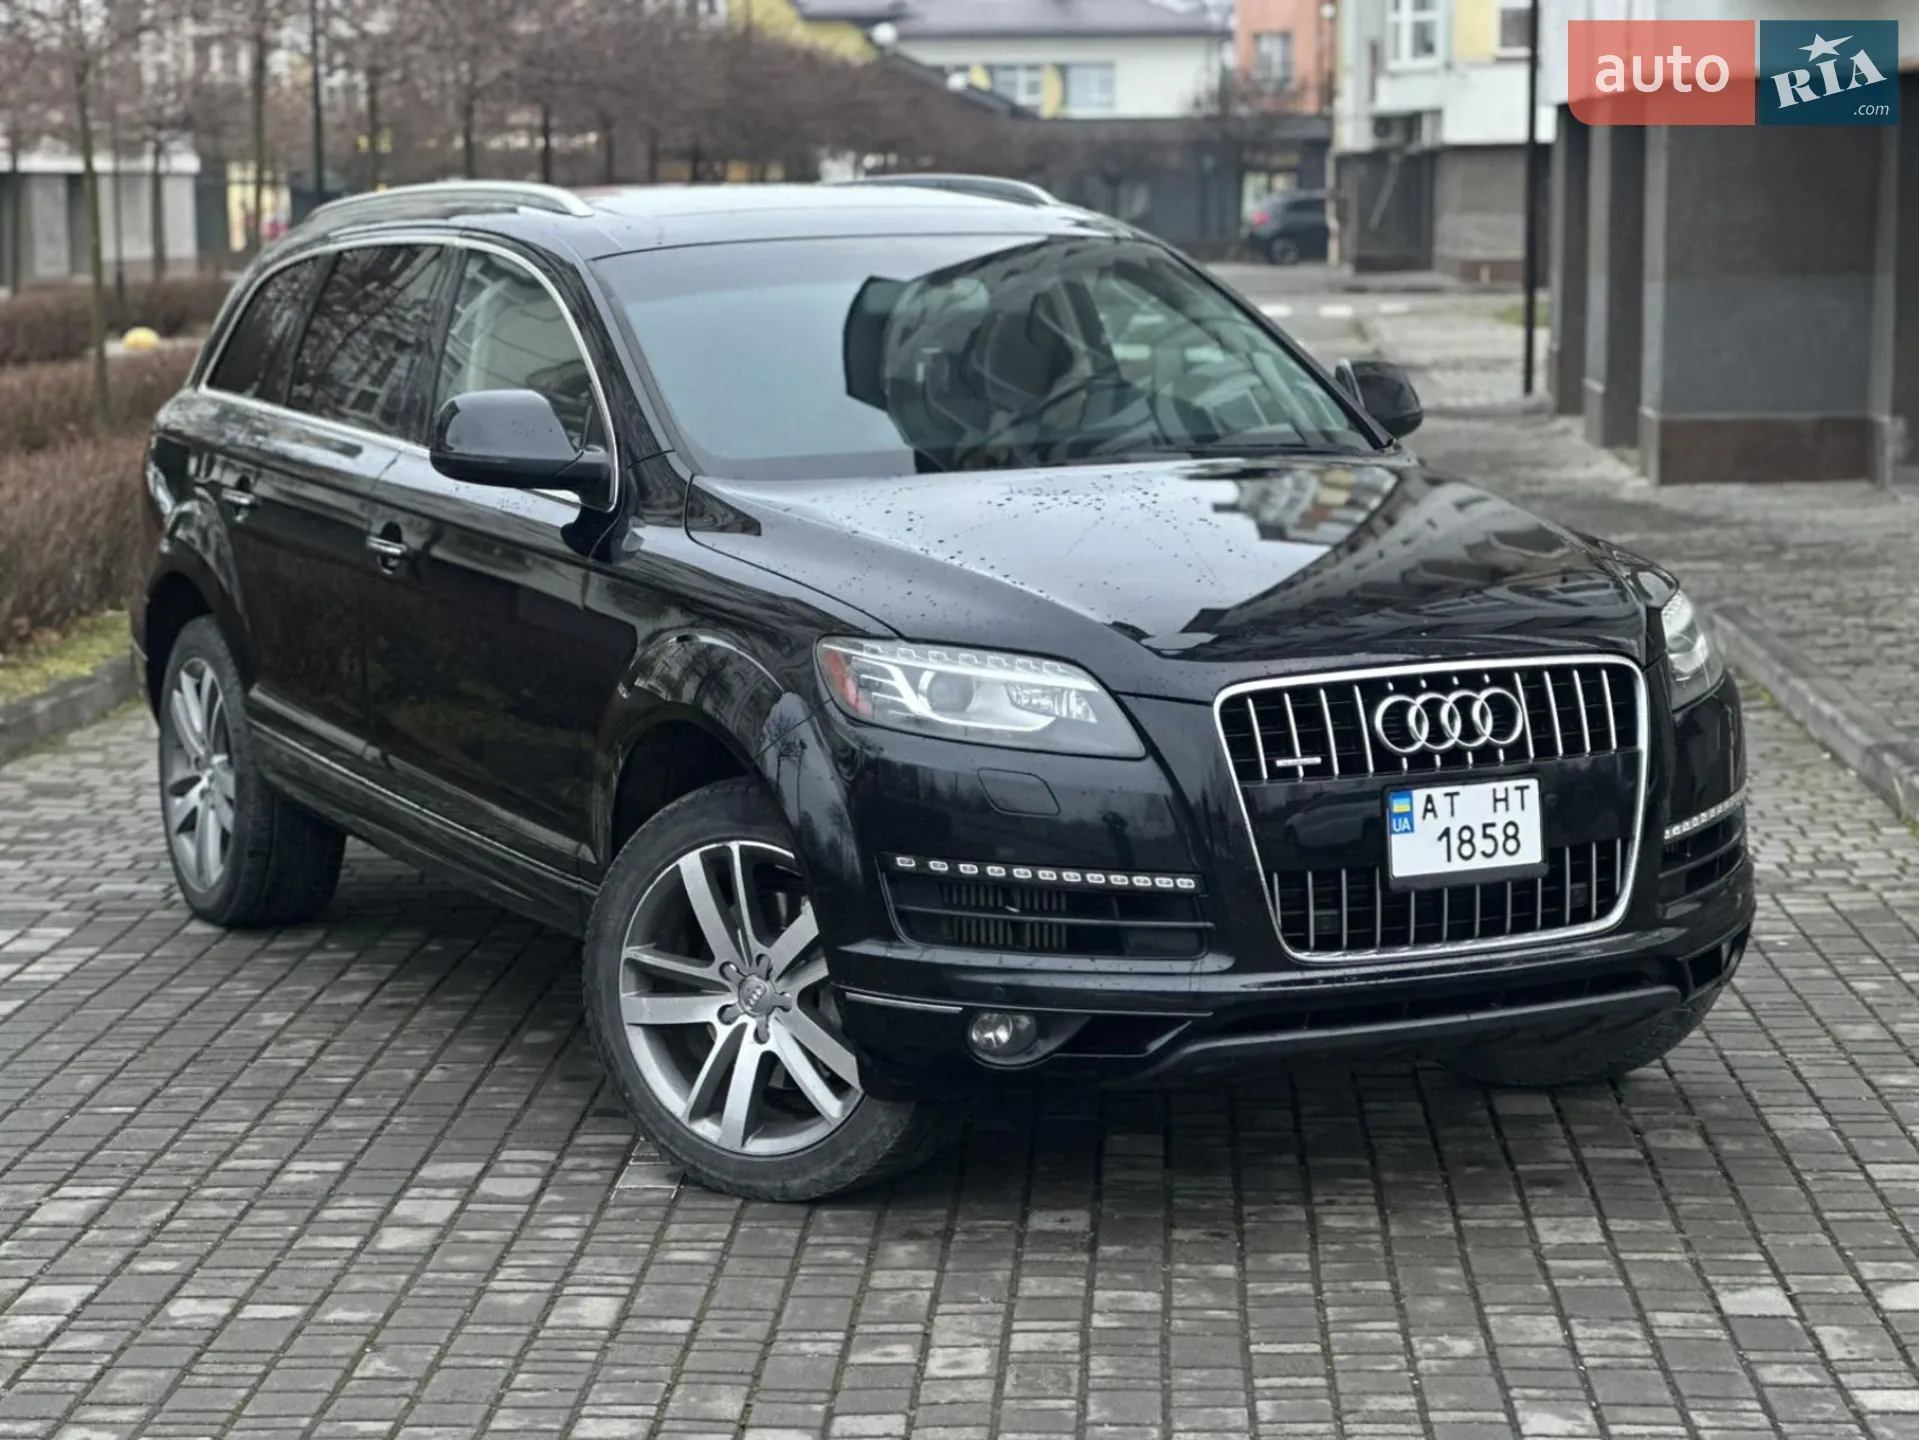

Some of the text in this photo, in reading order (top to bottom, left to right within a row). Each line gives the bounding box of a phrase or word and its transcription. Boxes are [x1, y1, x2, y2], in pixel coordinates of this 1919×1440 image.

[1422, 785, 1531, 820] AT HT
[1392, 817, 1412, 833] UA
[1437, 820, 1521, 863] 1858
